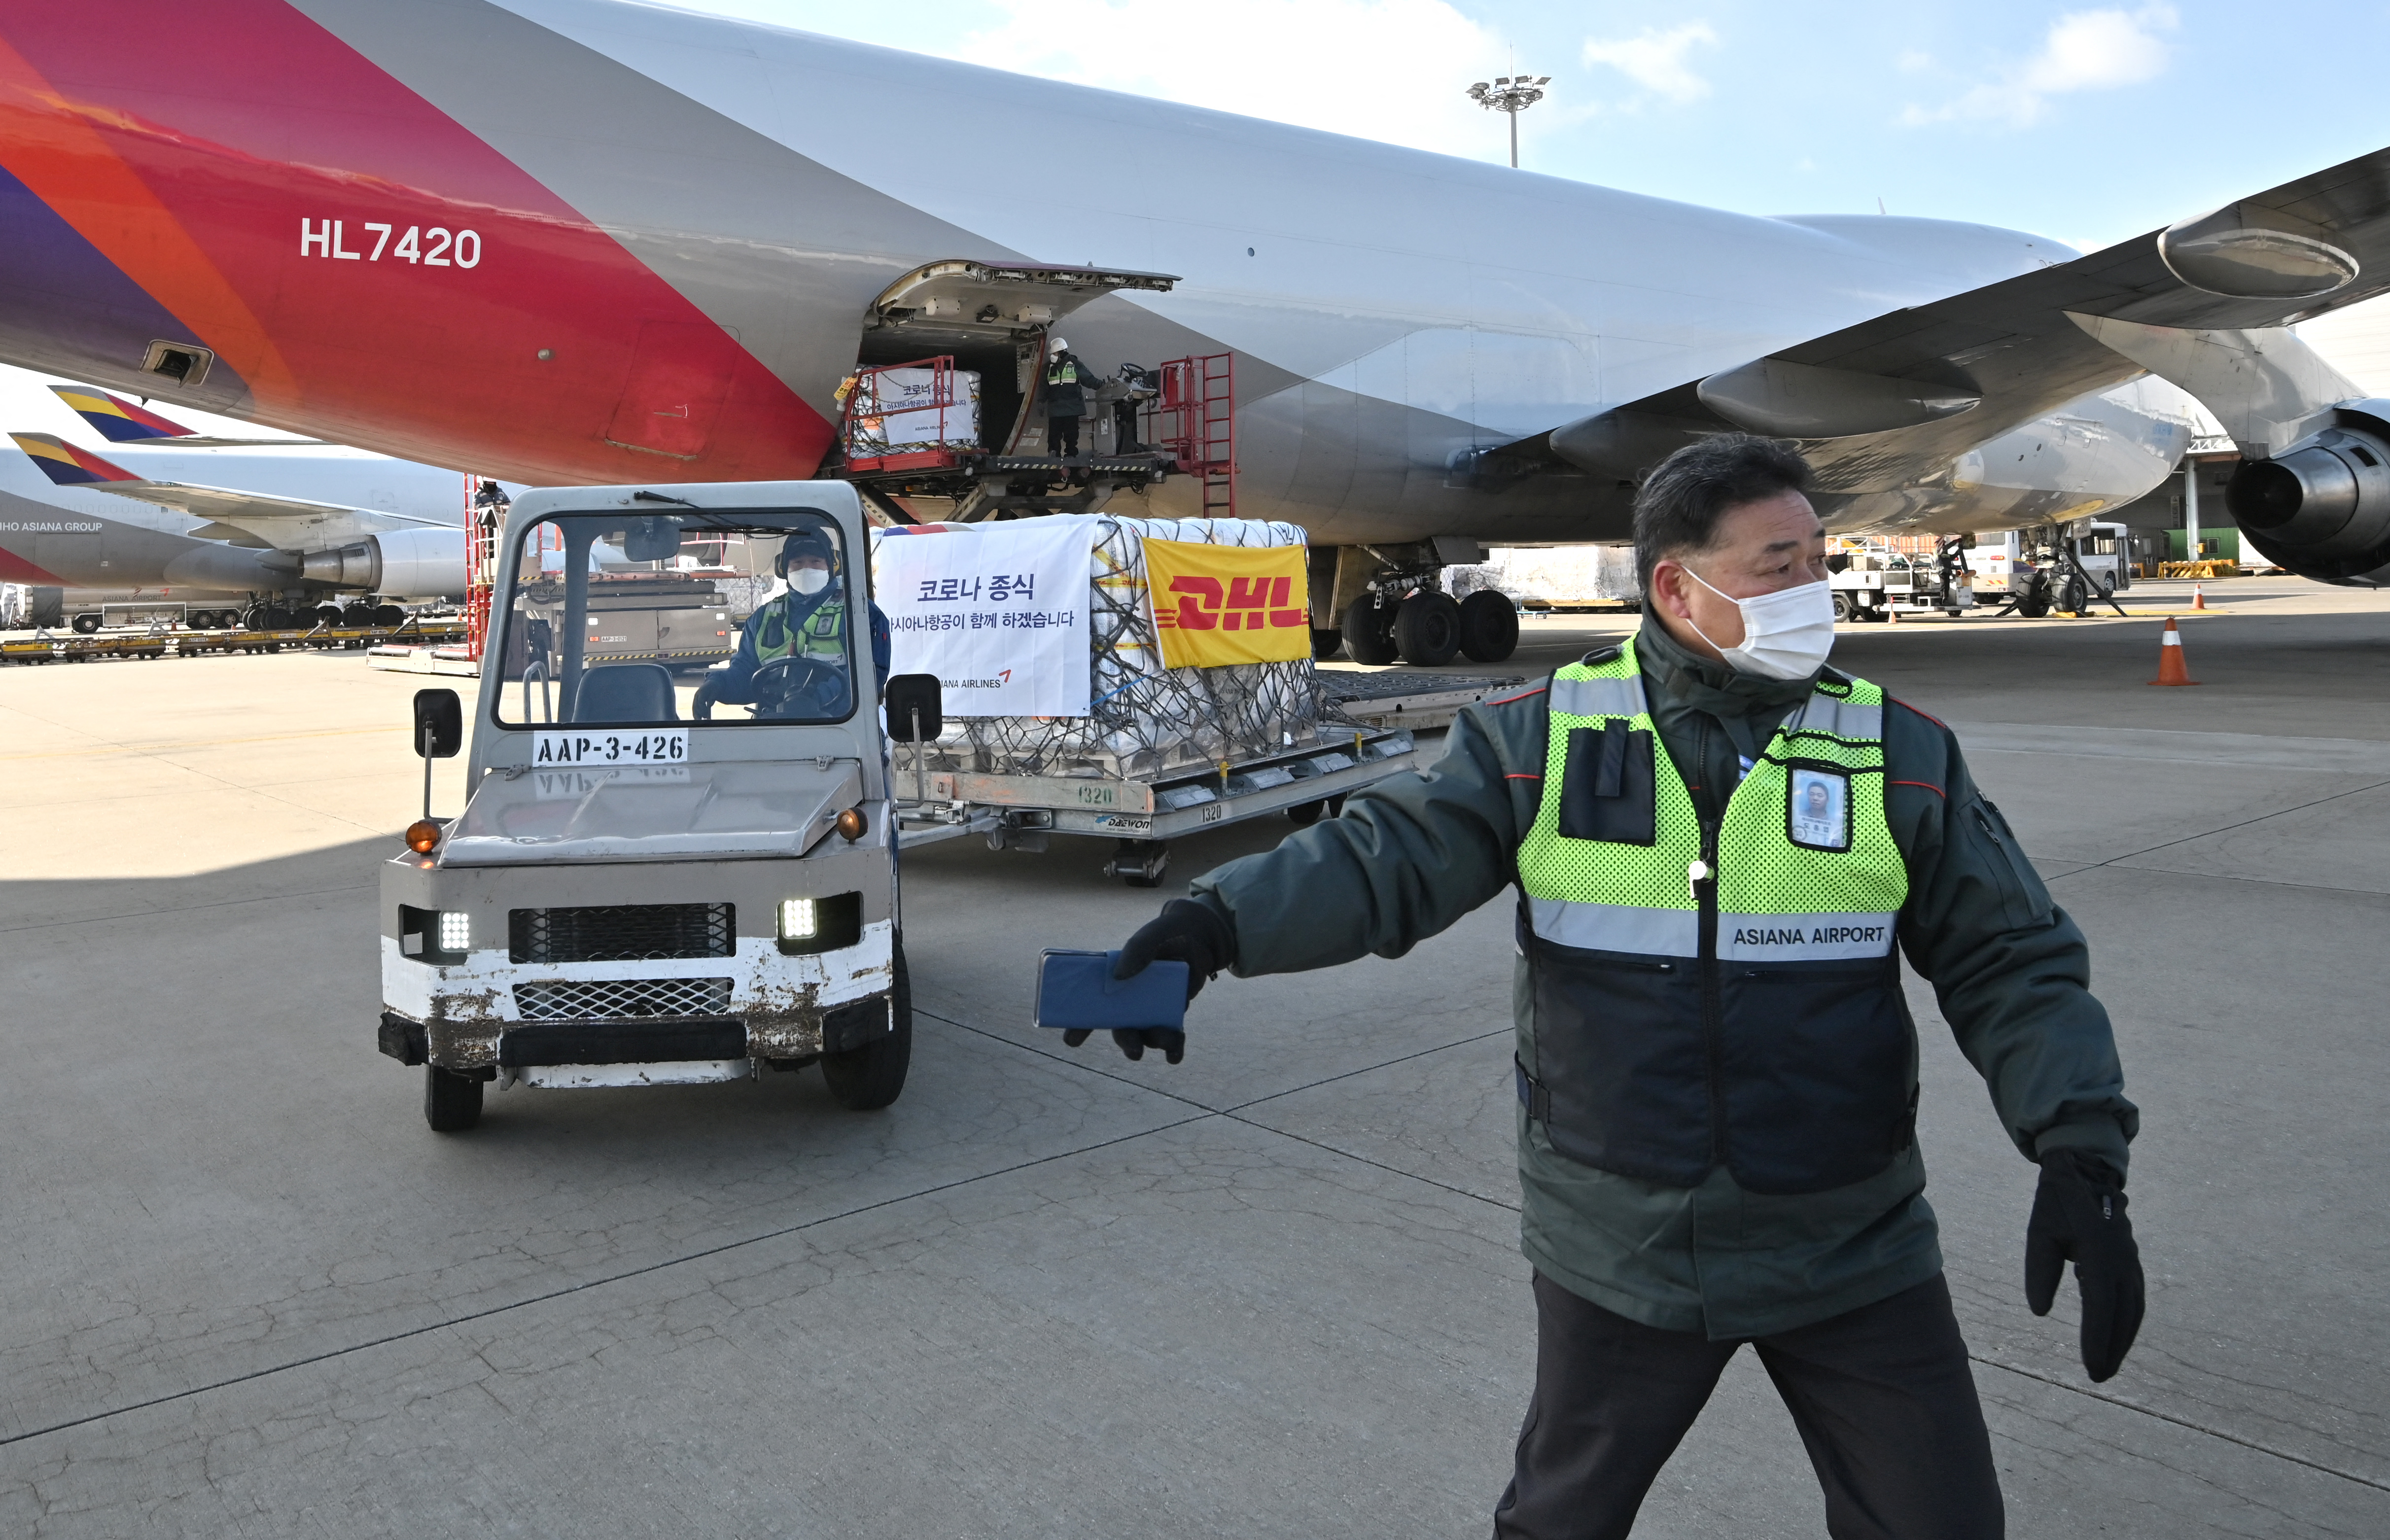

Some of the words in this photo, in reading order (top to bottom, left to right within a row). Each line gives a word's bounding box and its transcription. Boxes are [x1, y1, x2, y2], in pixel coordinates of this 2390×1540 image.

[301, 217, 481, 269] HL7420
[22, 522, 62, 531] ASIANA
[65, 522, 103, 531] GROUP
[917, 576, 982, 602] 코로나
[988, 573, 1035, 601] 종식
[1168, 575, 1304, 630] DHL
[970, 612, 997, 629] 함께
[1002, 610, 1074, 629] 하겠습니다
[941, 679, 958, 688] IANA
[961, 679, 1001, 689] AIRLINES
[537, 736, 683, 762] AAP-3-426
[1079, 786, 1112, 805] 1320
[1202, 804, 1222, 823] 1320
[1734, 928, 1805, 945] ASIANA
[1812, 927, 1885, 944] AIRPORT
